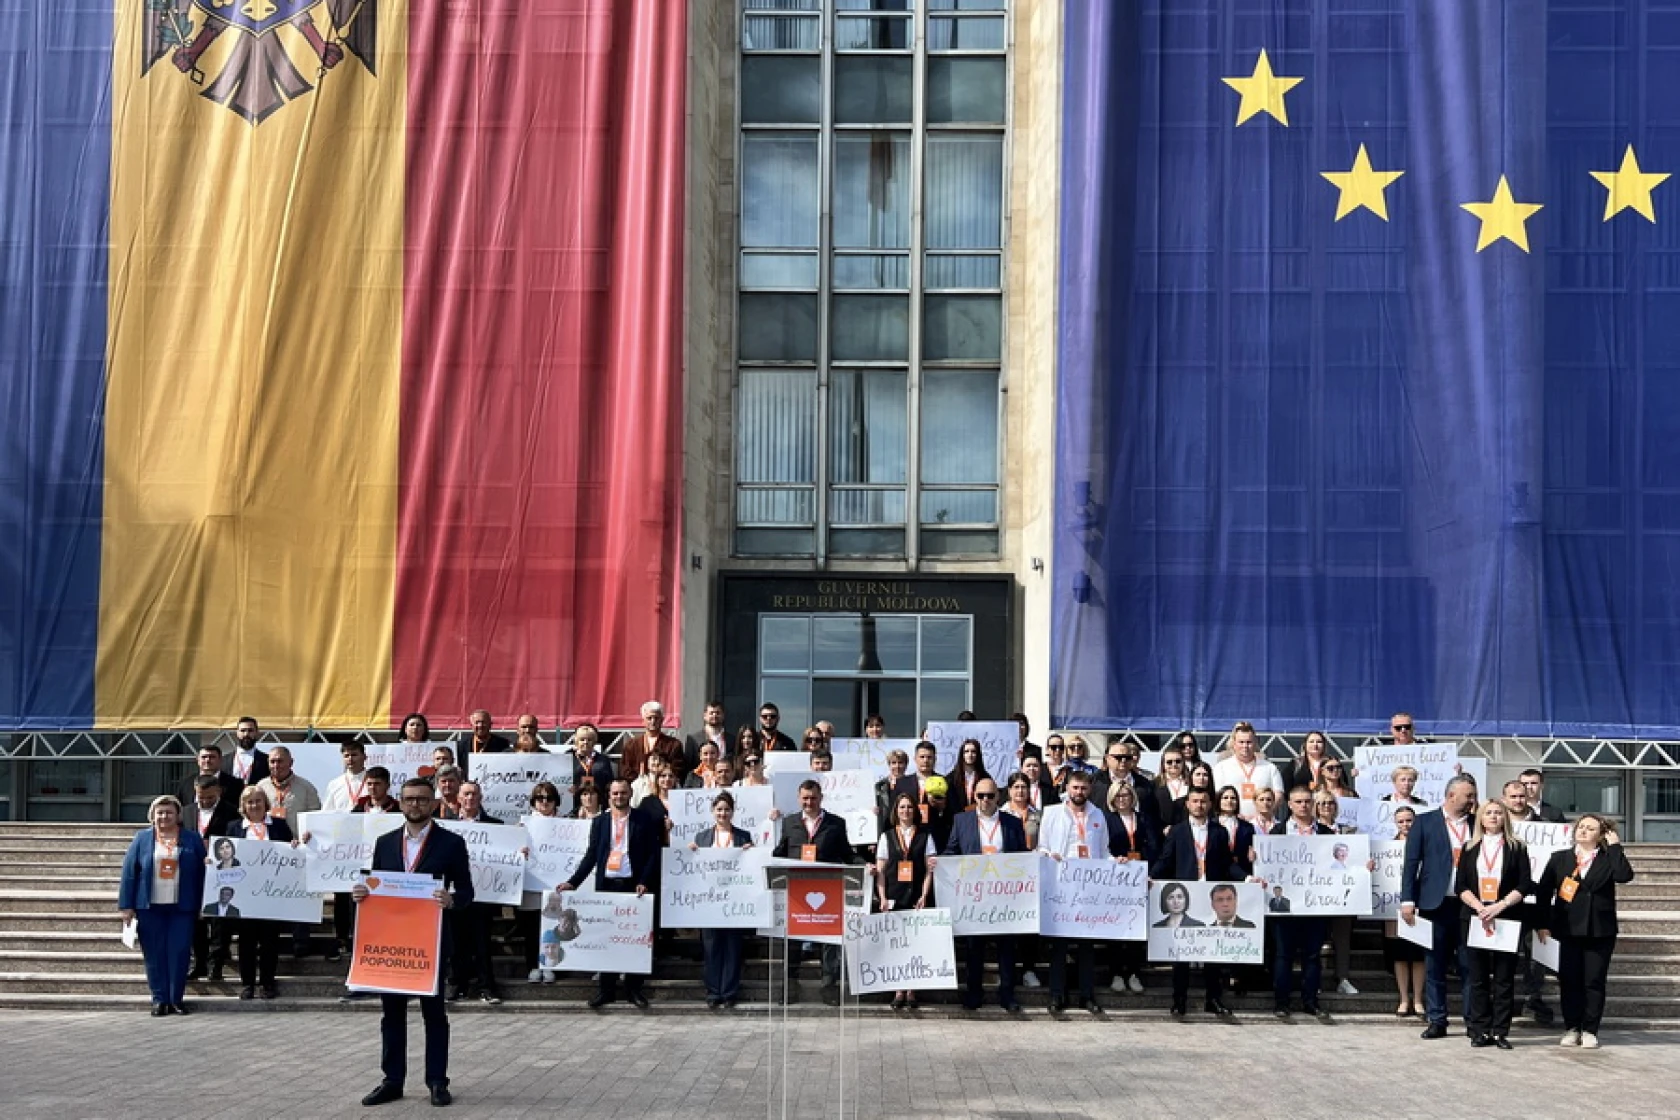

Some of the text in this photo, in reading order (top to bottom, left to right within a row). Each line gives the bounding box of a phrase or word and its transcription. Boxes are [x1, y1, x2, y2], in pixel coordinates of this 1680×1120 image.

[818, 581, 915, 595] GUVERNUL
[773, 595, 961, 610] REPUBLICII MOLDOVA
[958, 857, 1025, 878] PAS
[1060, 861, 1144, 891] Raportul
[1308, 867, 1333, 886] tine
[953, 904, 1037, 925] Moldova
[890, 936, 911, 950] nu
[363, 944, 429, 958] RAPORTUL
[360, 955, 431, 970] POPORULUI
